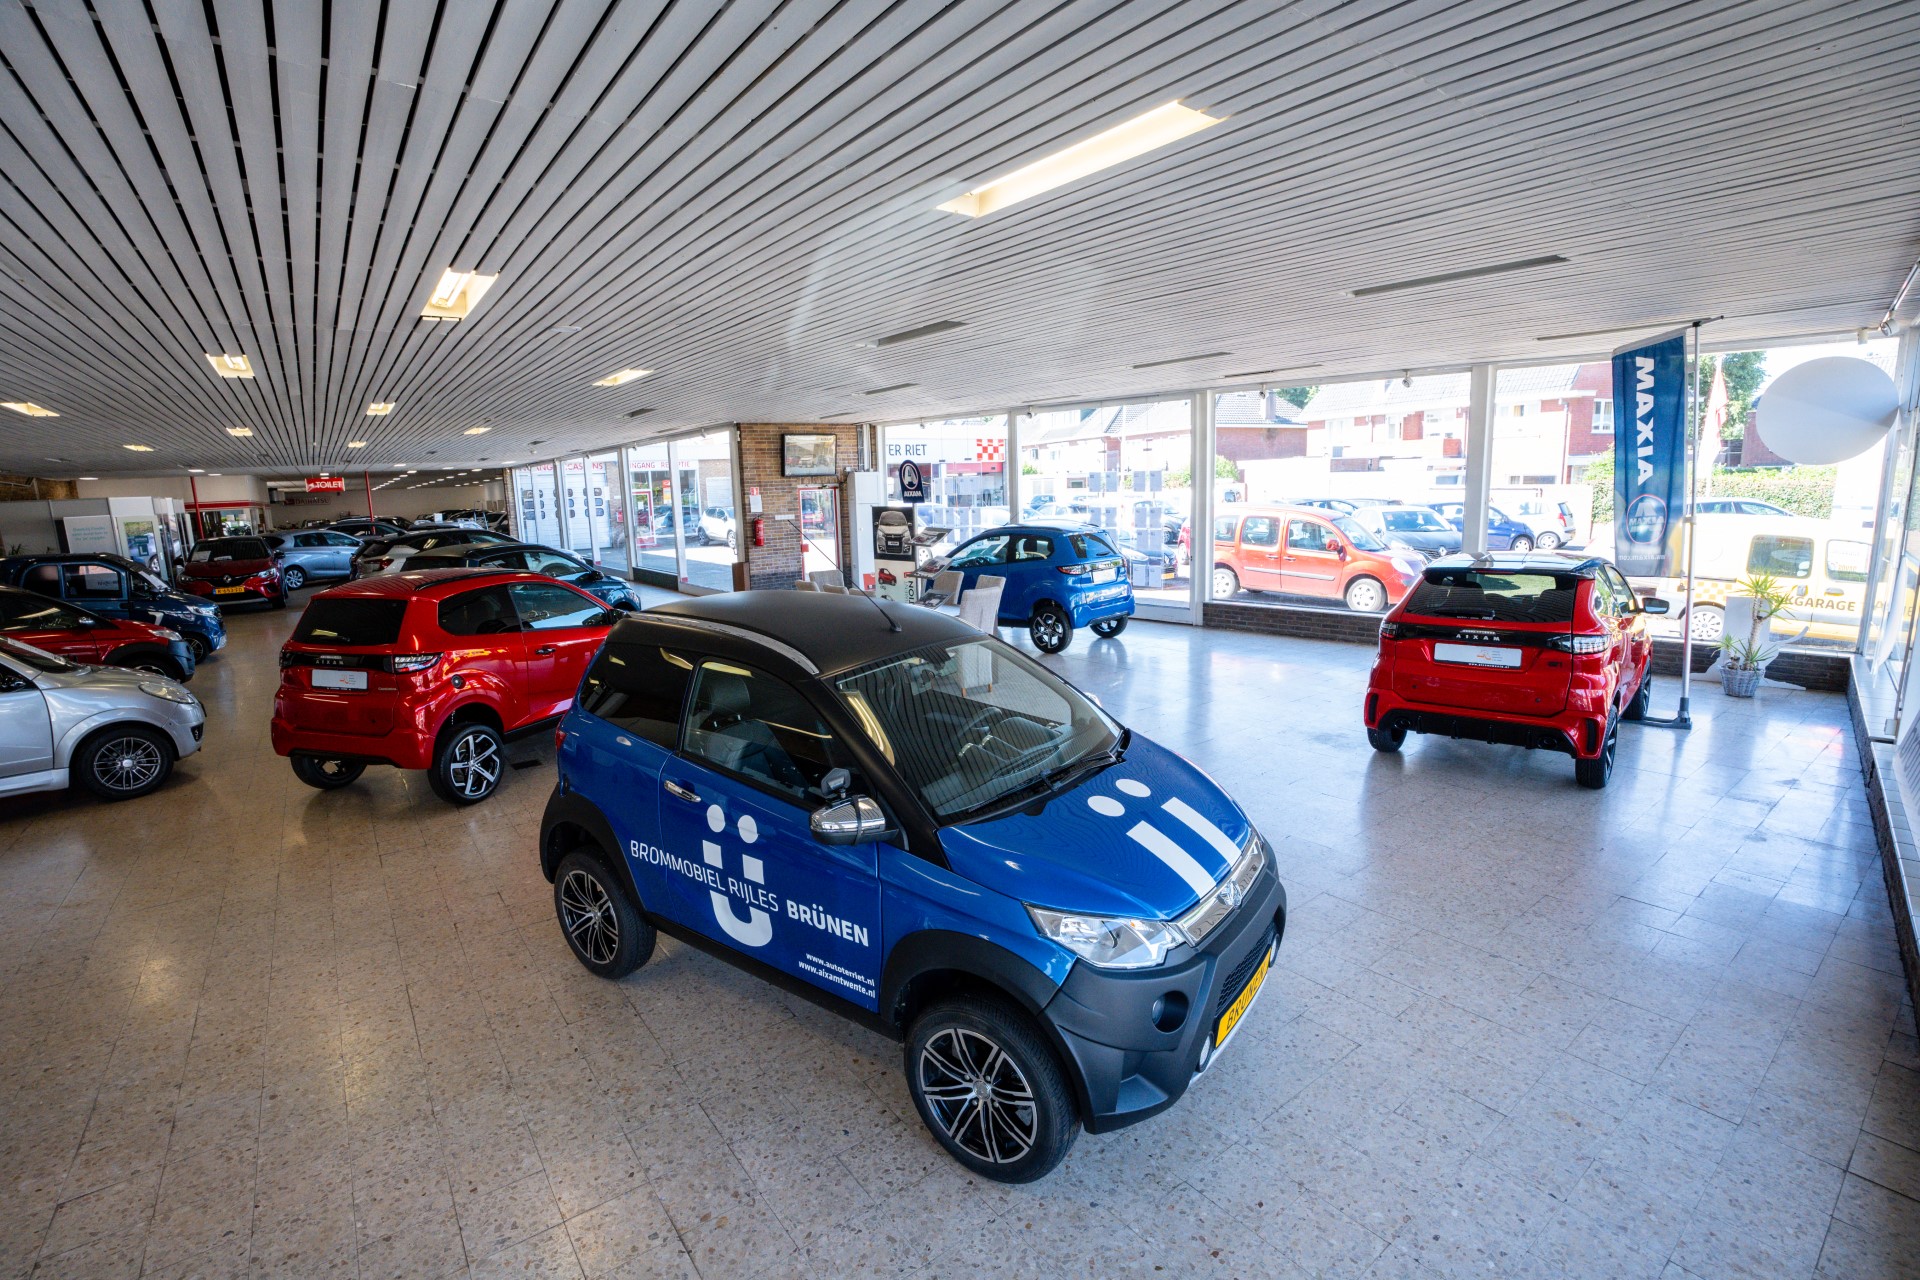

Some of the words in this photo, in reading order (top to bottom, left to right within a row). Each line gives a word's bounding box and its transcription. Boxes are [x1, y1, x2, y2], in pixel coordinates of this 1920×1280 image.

[886, 444, 902, 456] ER
[905, 444, 927, 456] RIET
[315, 481, 341, 489] TOILET
[630, 839, 726, 892] BROMMOBIEL
[728, 877, 779, 912] RIJLES
[786, 899, 869, 948] BRÜNEN
[798, 960, 876, 999] www.aixamtwente.nl
[805, 952, 875, 987] www.autoterriet.nl
